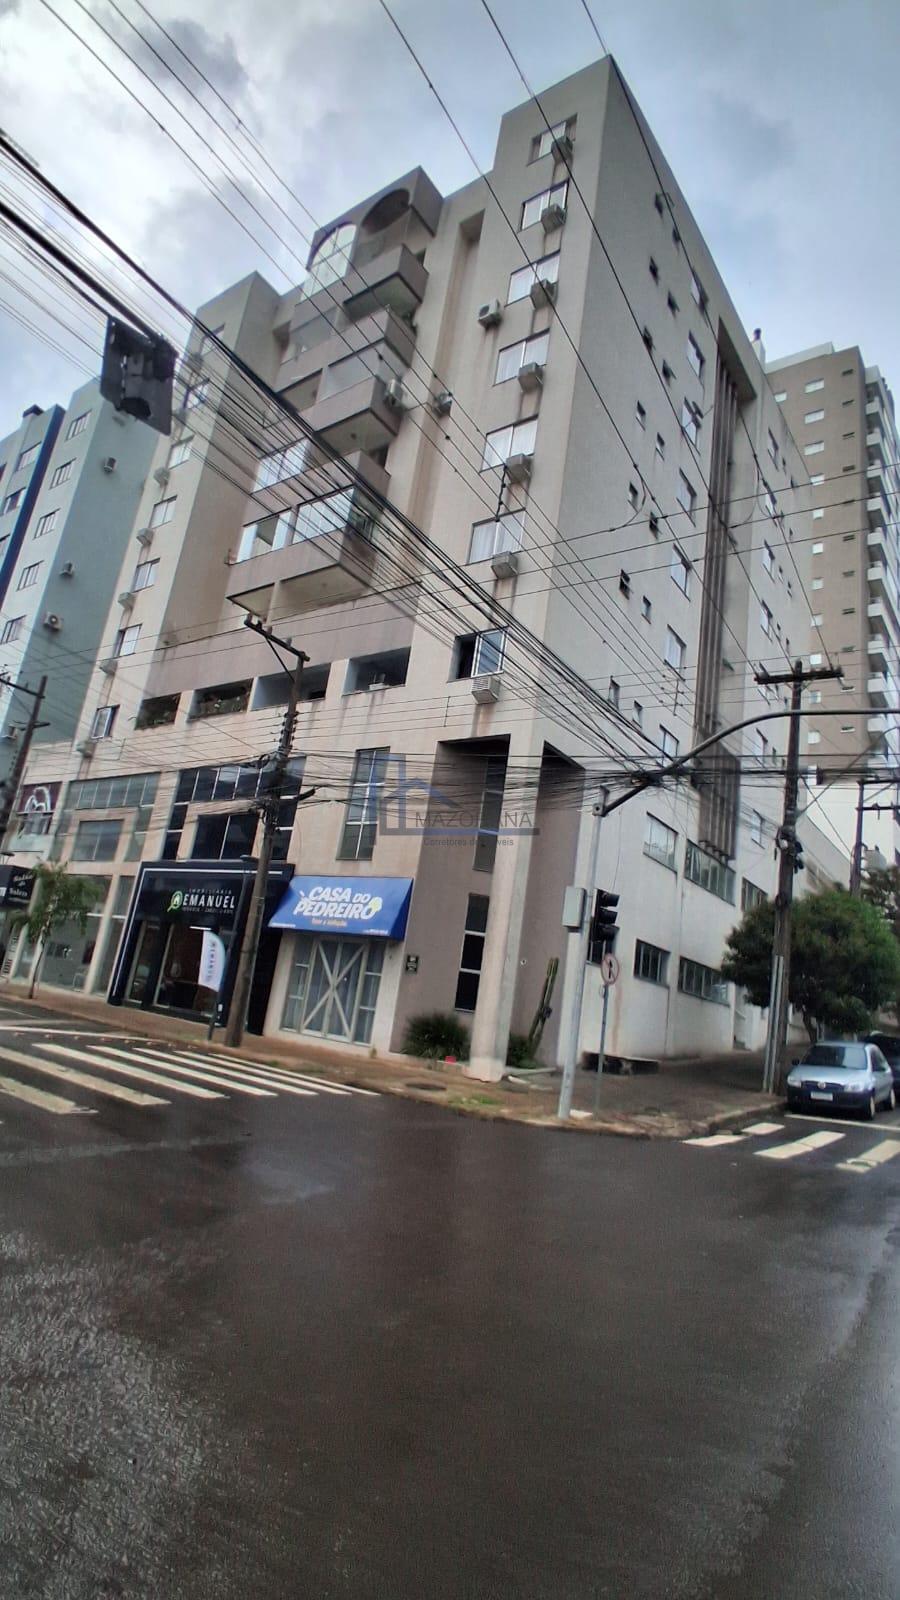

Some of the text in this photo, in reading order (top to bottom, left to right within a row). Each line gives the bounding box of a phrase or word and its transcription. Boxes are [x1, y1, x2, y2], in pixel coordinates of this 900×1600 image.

[183, 893, 235, 909] EMANUEL
[308, 886, 372, 904] CASA DO
[293, 900, 376, 920] PEDREIRO
